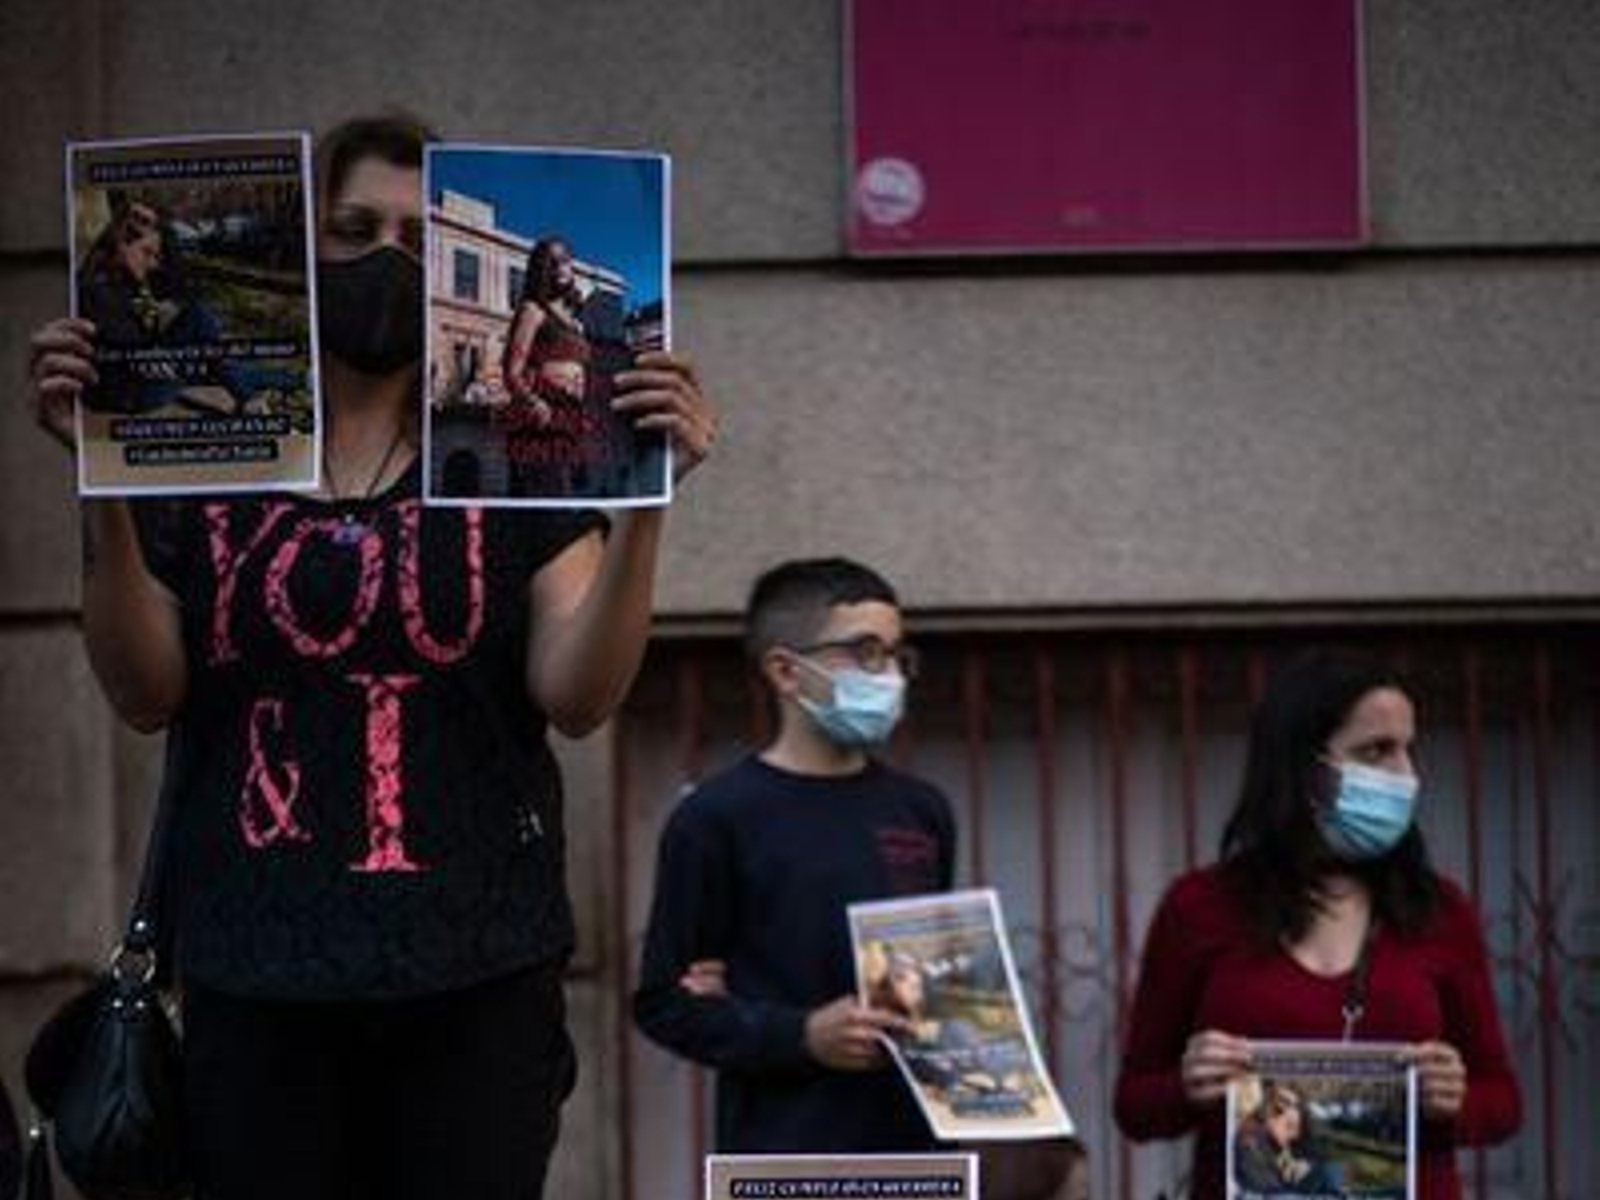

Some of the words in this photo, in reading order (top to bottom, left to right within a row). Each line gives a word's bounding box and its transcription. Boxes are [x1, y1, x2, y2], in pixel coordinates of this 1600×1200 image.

[204, 502, 484, 663] YOU
[242, 697, 312, 847] &
[347, 673, 430, 871] I
